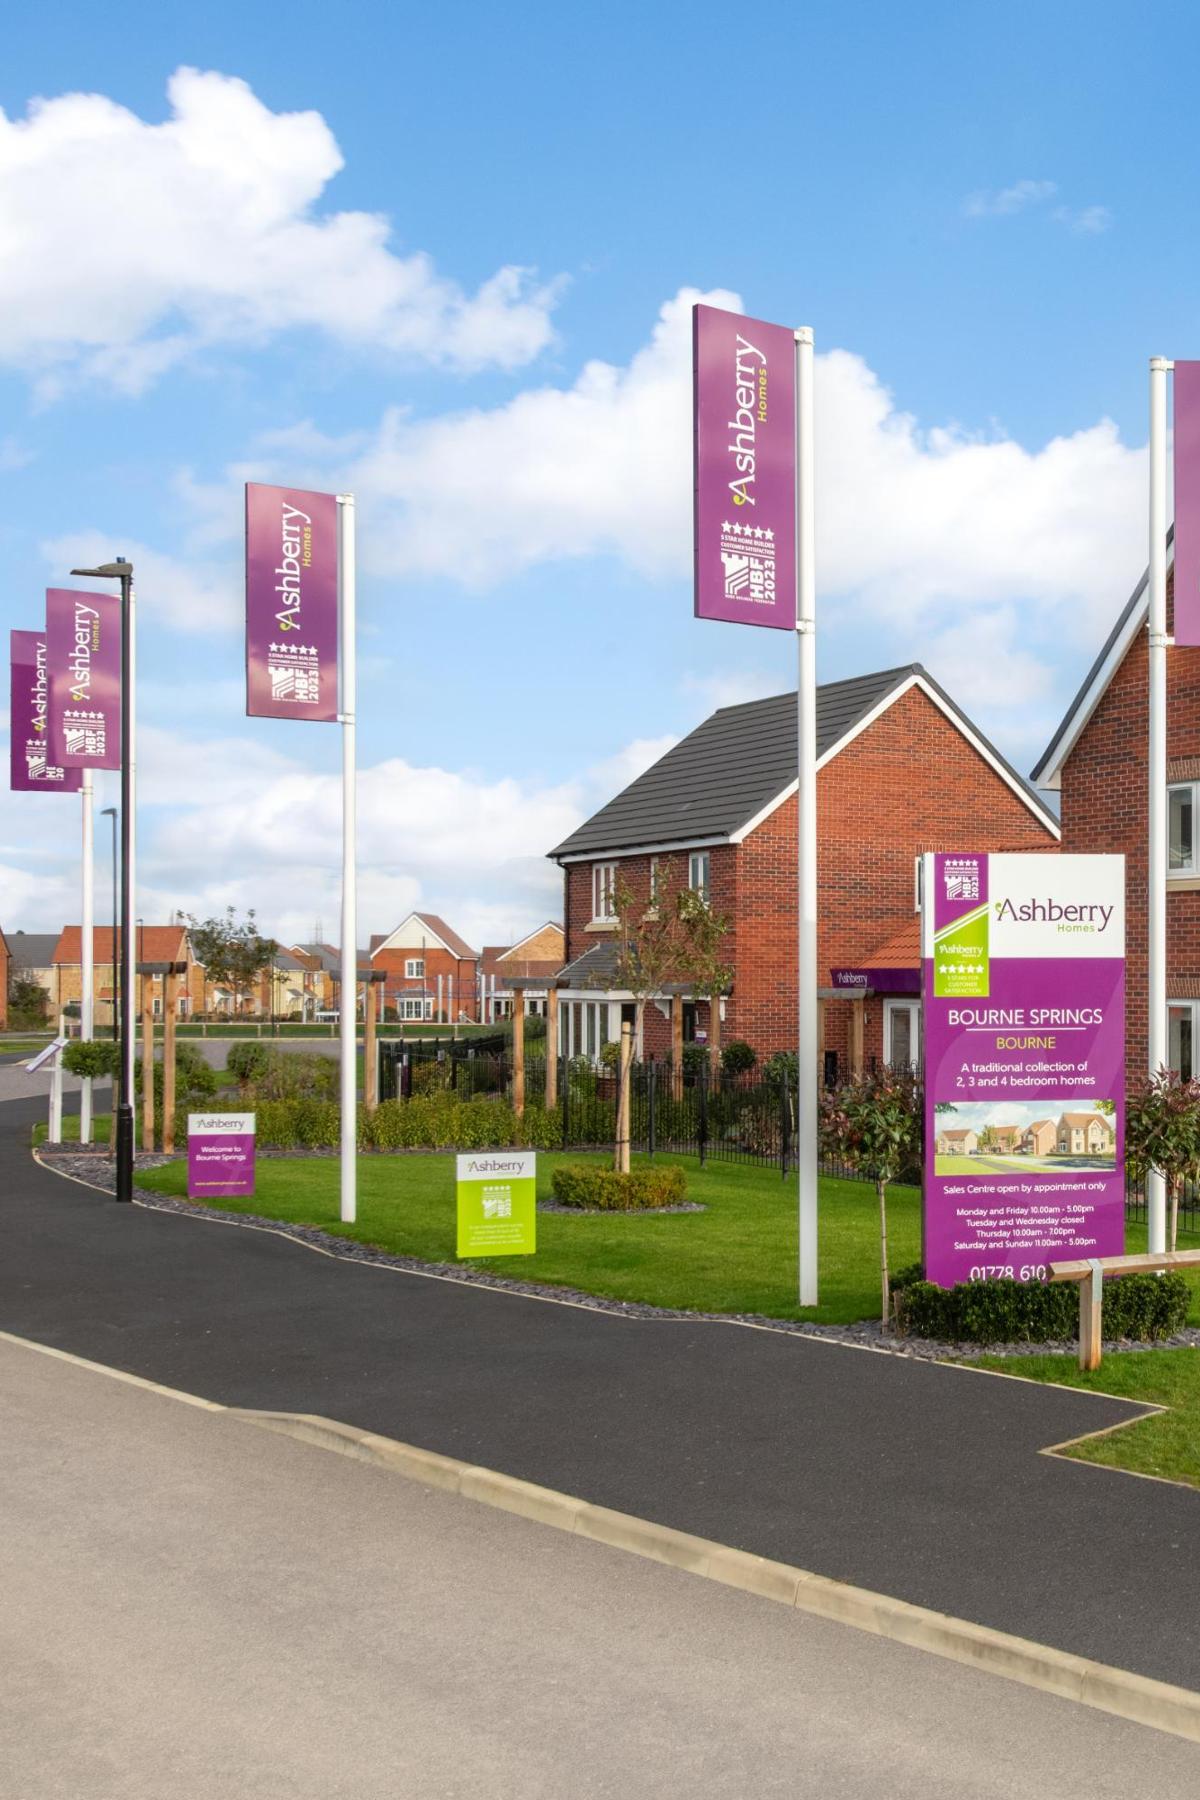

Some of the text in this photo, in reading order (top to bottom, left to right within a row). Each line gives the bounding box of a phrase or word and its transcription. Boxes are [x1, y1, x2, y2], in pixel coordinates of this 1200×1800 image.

[757, 368, 767, 423] Homes
[728, 333, 766, 506] Ashberry
[302, 525, 312, 567] Homes
[275, 502, 311, 631] Ashberry
[750, 557, 764, 599] HBF
[764, 560, 775, 601] 2023
[70, 602, 99, 701] Ashberry
[295, 668, 308, 699] HBF
[309, 670, 319, 701] 2023
[85, 730, 97, 753] HBF
[97, 731, 105, 754] 2023
[962, 877, 971, 898] HBF
[995, 898, 1114, 932] Ashberry
[1057, 924, 1095, 933] Homes
[939, 944, 984, 957] Ashberry
[837, 972, 868, 988] Ashberry
[948, 1008, 1103, 1025] BOURNE SPRINGS
[996, 1037, 1056, 1049] BOURNE
[961, 1061, 1088, 1073] A traditional collection of
[957, 1075, 1096, 1088] 2, 3 and 4 bedroom homes
[197, 1118, 245, 1131] Ashberry
[221, 1154, 247, 1162] Springs
[468, 1160, 525, 1175] Ashberry
[943, 1182, 1106, 1195] Sales Centre open by appointment only
[956, 1207, 988, 1217] Monday
[989, 1207, 1004, 1215] and
[1006, 1206, 1029, 1216] Friday
[1066, 1205, 1094, 1214] 5.00pm
[966, 1216, 1084, 1228] Tuesday and Wednesday closed
[976, 1229, 1011, 1239] Thursday
[954, 1241, 987, 1250] Saturday
[989, 1240, 1004, 1248] and
[1005, 1240, 1033, 1249] Sunday
[1069, 1238, 1096, 1247] 5.00pm
[1020, 1264, 1047, 1281] 610
